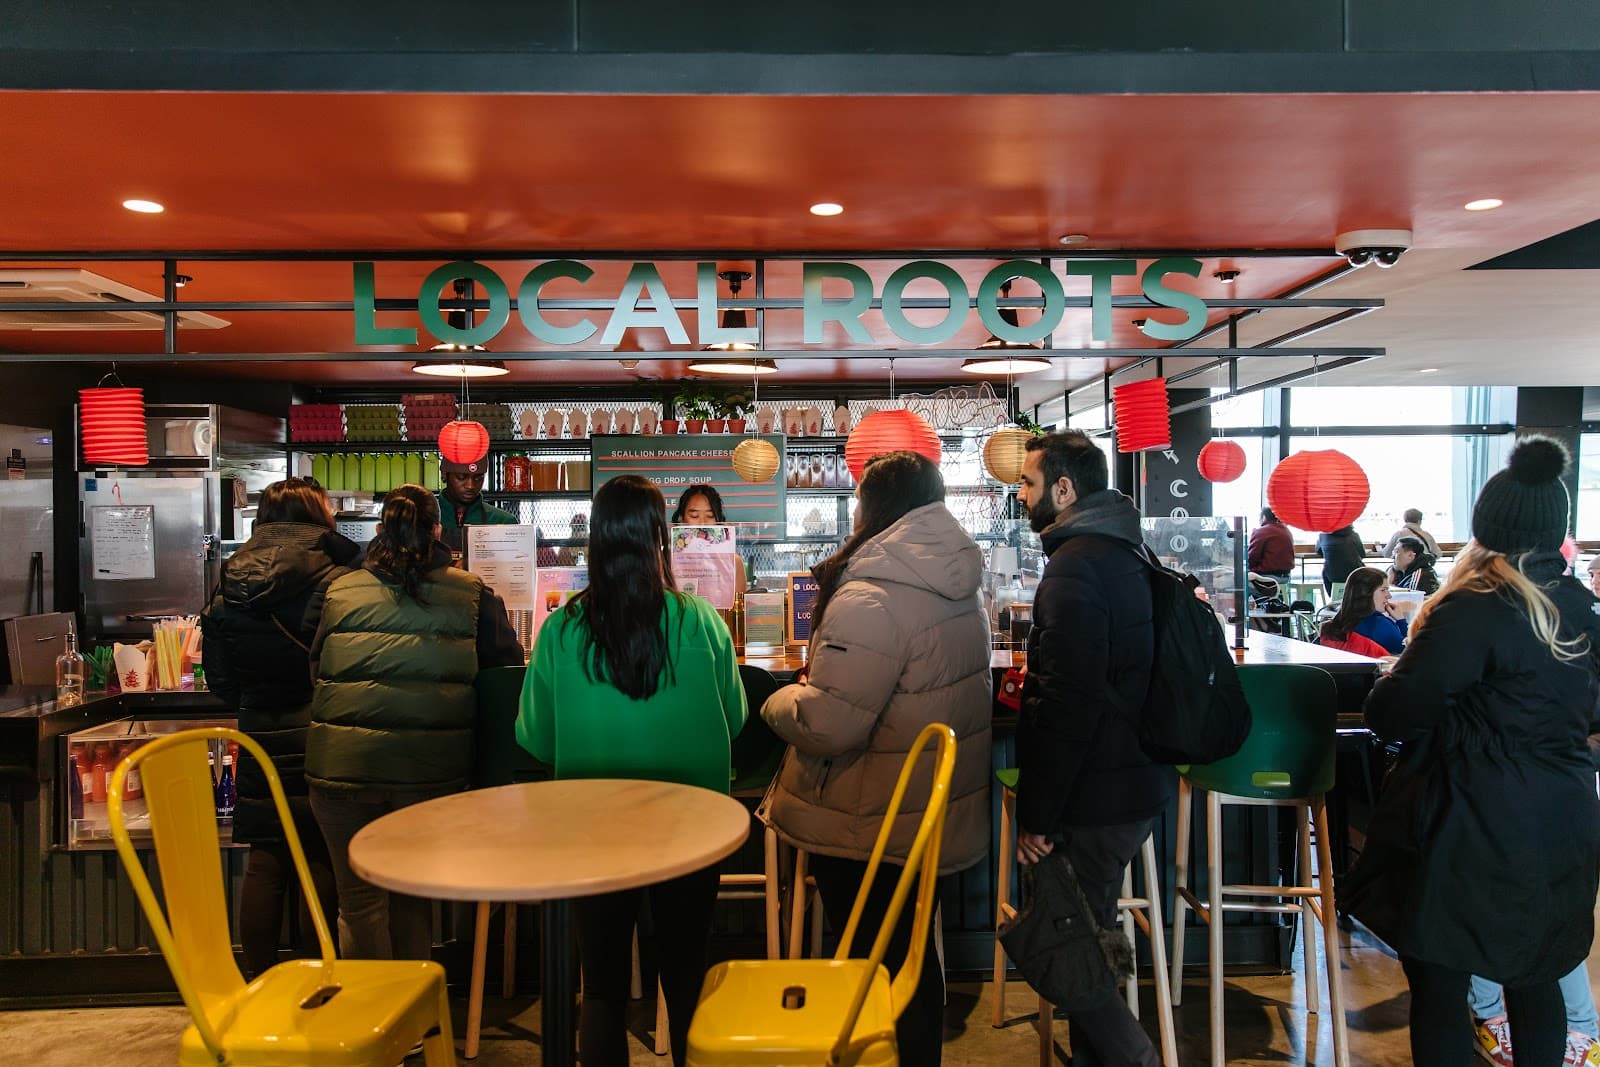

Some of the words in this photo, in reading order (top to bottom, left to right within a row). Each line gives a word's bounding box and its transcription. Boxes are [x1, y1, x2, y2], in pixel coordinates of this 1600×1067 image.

[353, 259, 759, 345] LOCAL
[803, 257, 1208, 344] ROOTS
[658, 449, 698, 457] PANCAKE
